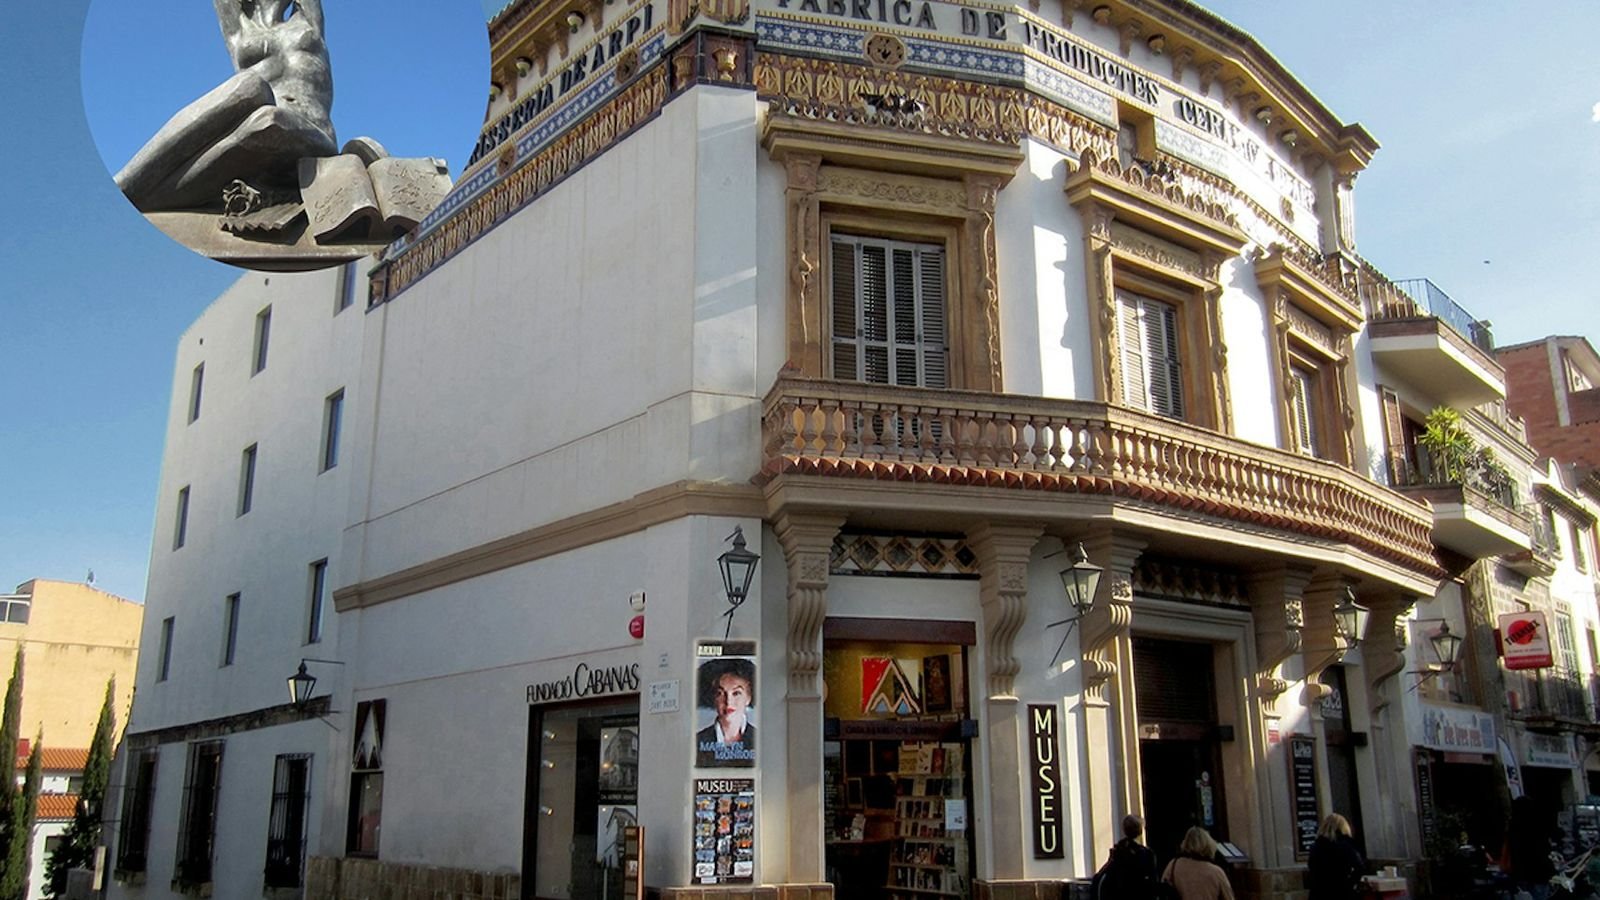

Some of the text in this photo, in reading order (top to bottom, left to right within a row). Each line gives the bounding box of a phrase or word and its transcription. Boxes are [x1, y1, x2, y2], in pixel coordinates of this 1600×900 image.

[558, 54, 587, 98] DE
[590, 3, 654, 74] ARPI
[960, 7, 1007, 41] DE
[1025, 21, 1160, 106] PRODUCTES
[526, 662, 640, 703] FUNDACIÓ CABANAS
[697, 780, 733, 793] MUSEU
[1033, 707, 1057, 854] MUSEU
